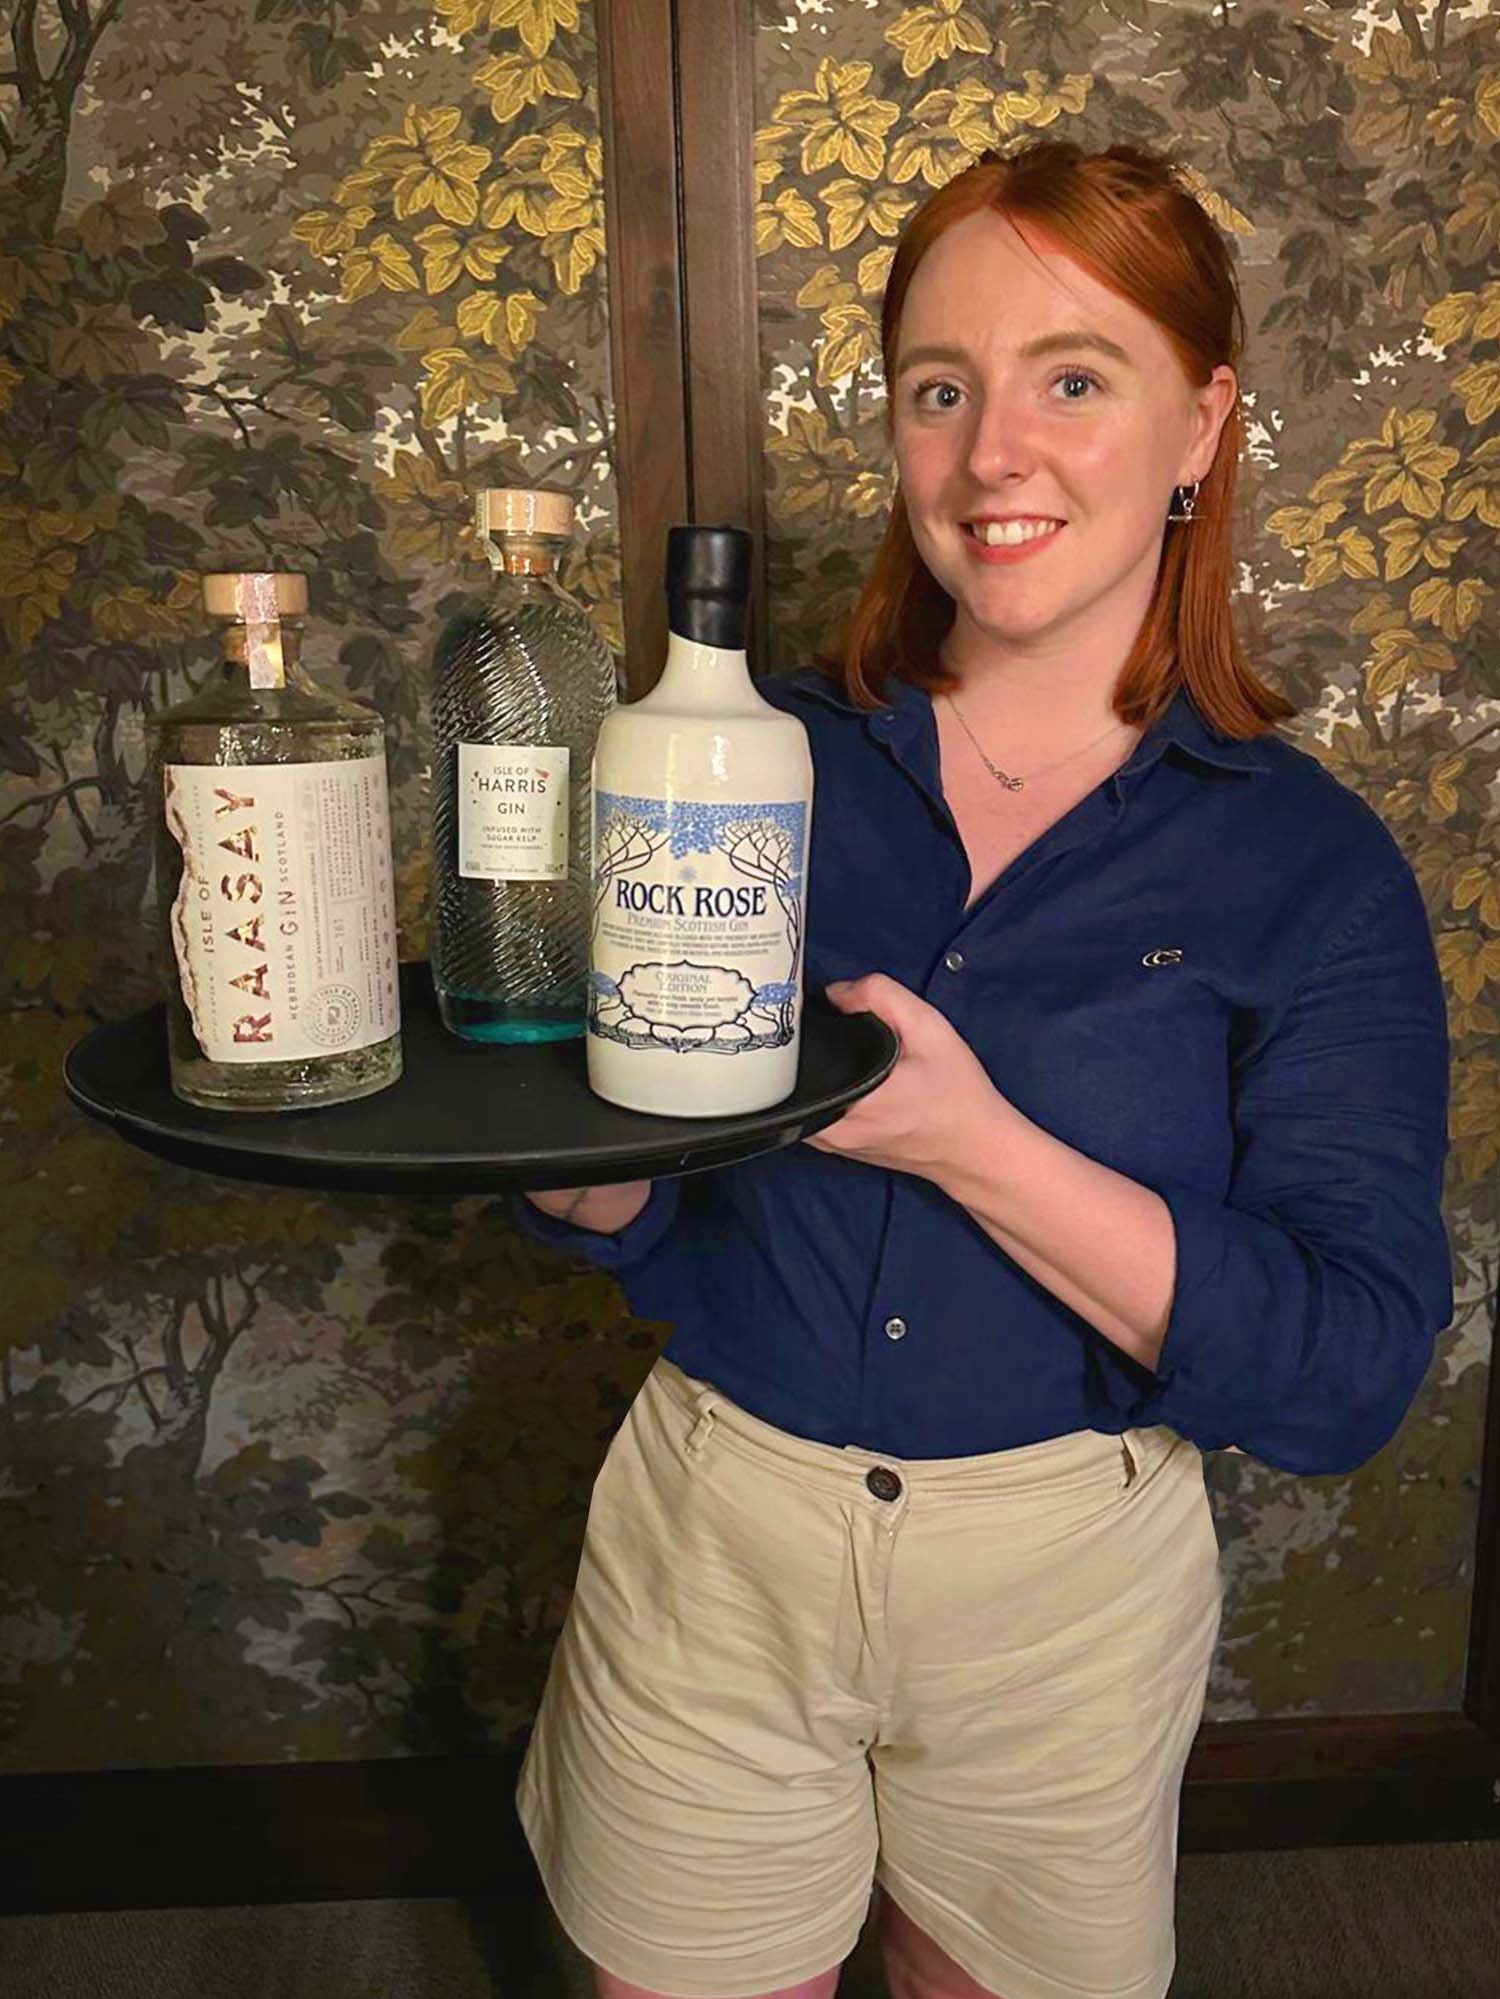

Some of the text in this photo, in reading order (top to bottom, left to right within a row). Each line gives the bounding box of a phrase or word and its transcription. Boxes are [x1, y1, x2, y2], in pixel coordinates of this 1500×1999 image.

[493, 766, 529, 776] ISLE OF
[478, 778, 547, 793] HARRIS
[497, 802, 525, 815] GIN
[482, 826, 518, 834] INFUSED
[486, 834, 514, 842] SUGAR
[616, 879, 767, 918] ROCK ROSE
[197, 875, 215, 953] ISLE OF
[213, 787, 274, 1044] RAASAY
[274, 810, 299, 1021] HEBRIDEAN GIN SCOTLAND
